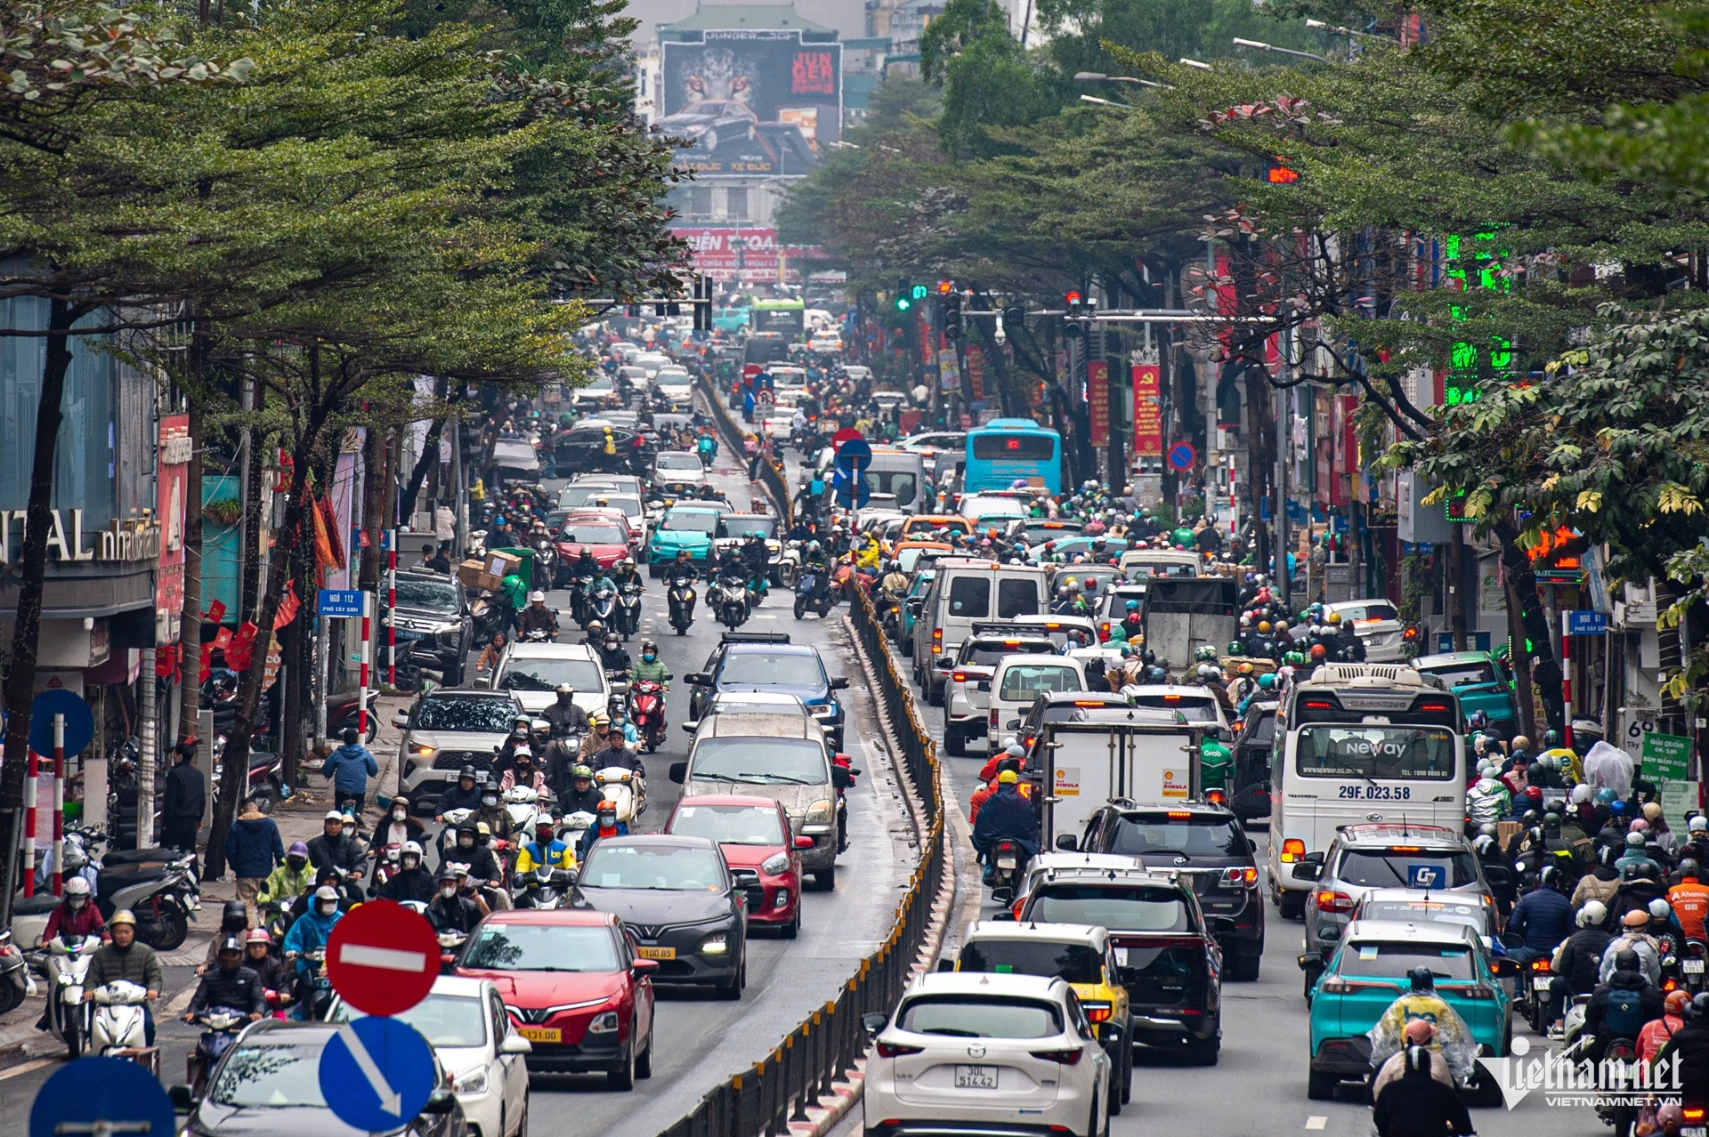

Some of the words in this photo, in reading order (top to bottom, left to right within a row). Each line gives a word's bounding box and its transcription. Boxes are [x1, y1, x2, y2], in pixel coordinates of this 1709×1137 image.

[344, 594, 354, 603] 112
[967, 1066, 985, 1076] 30L
[959, 1076, 993, 1087] 514.42
